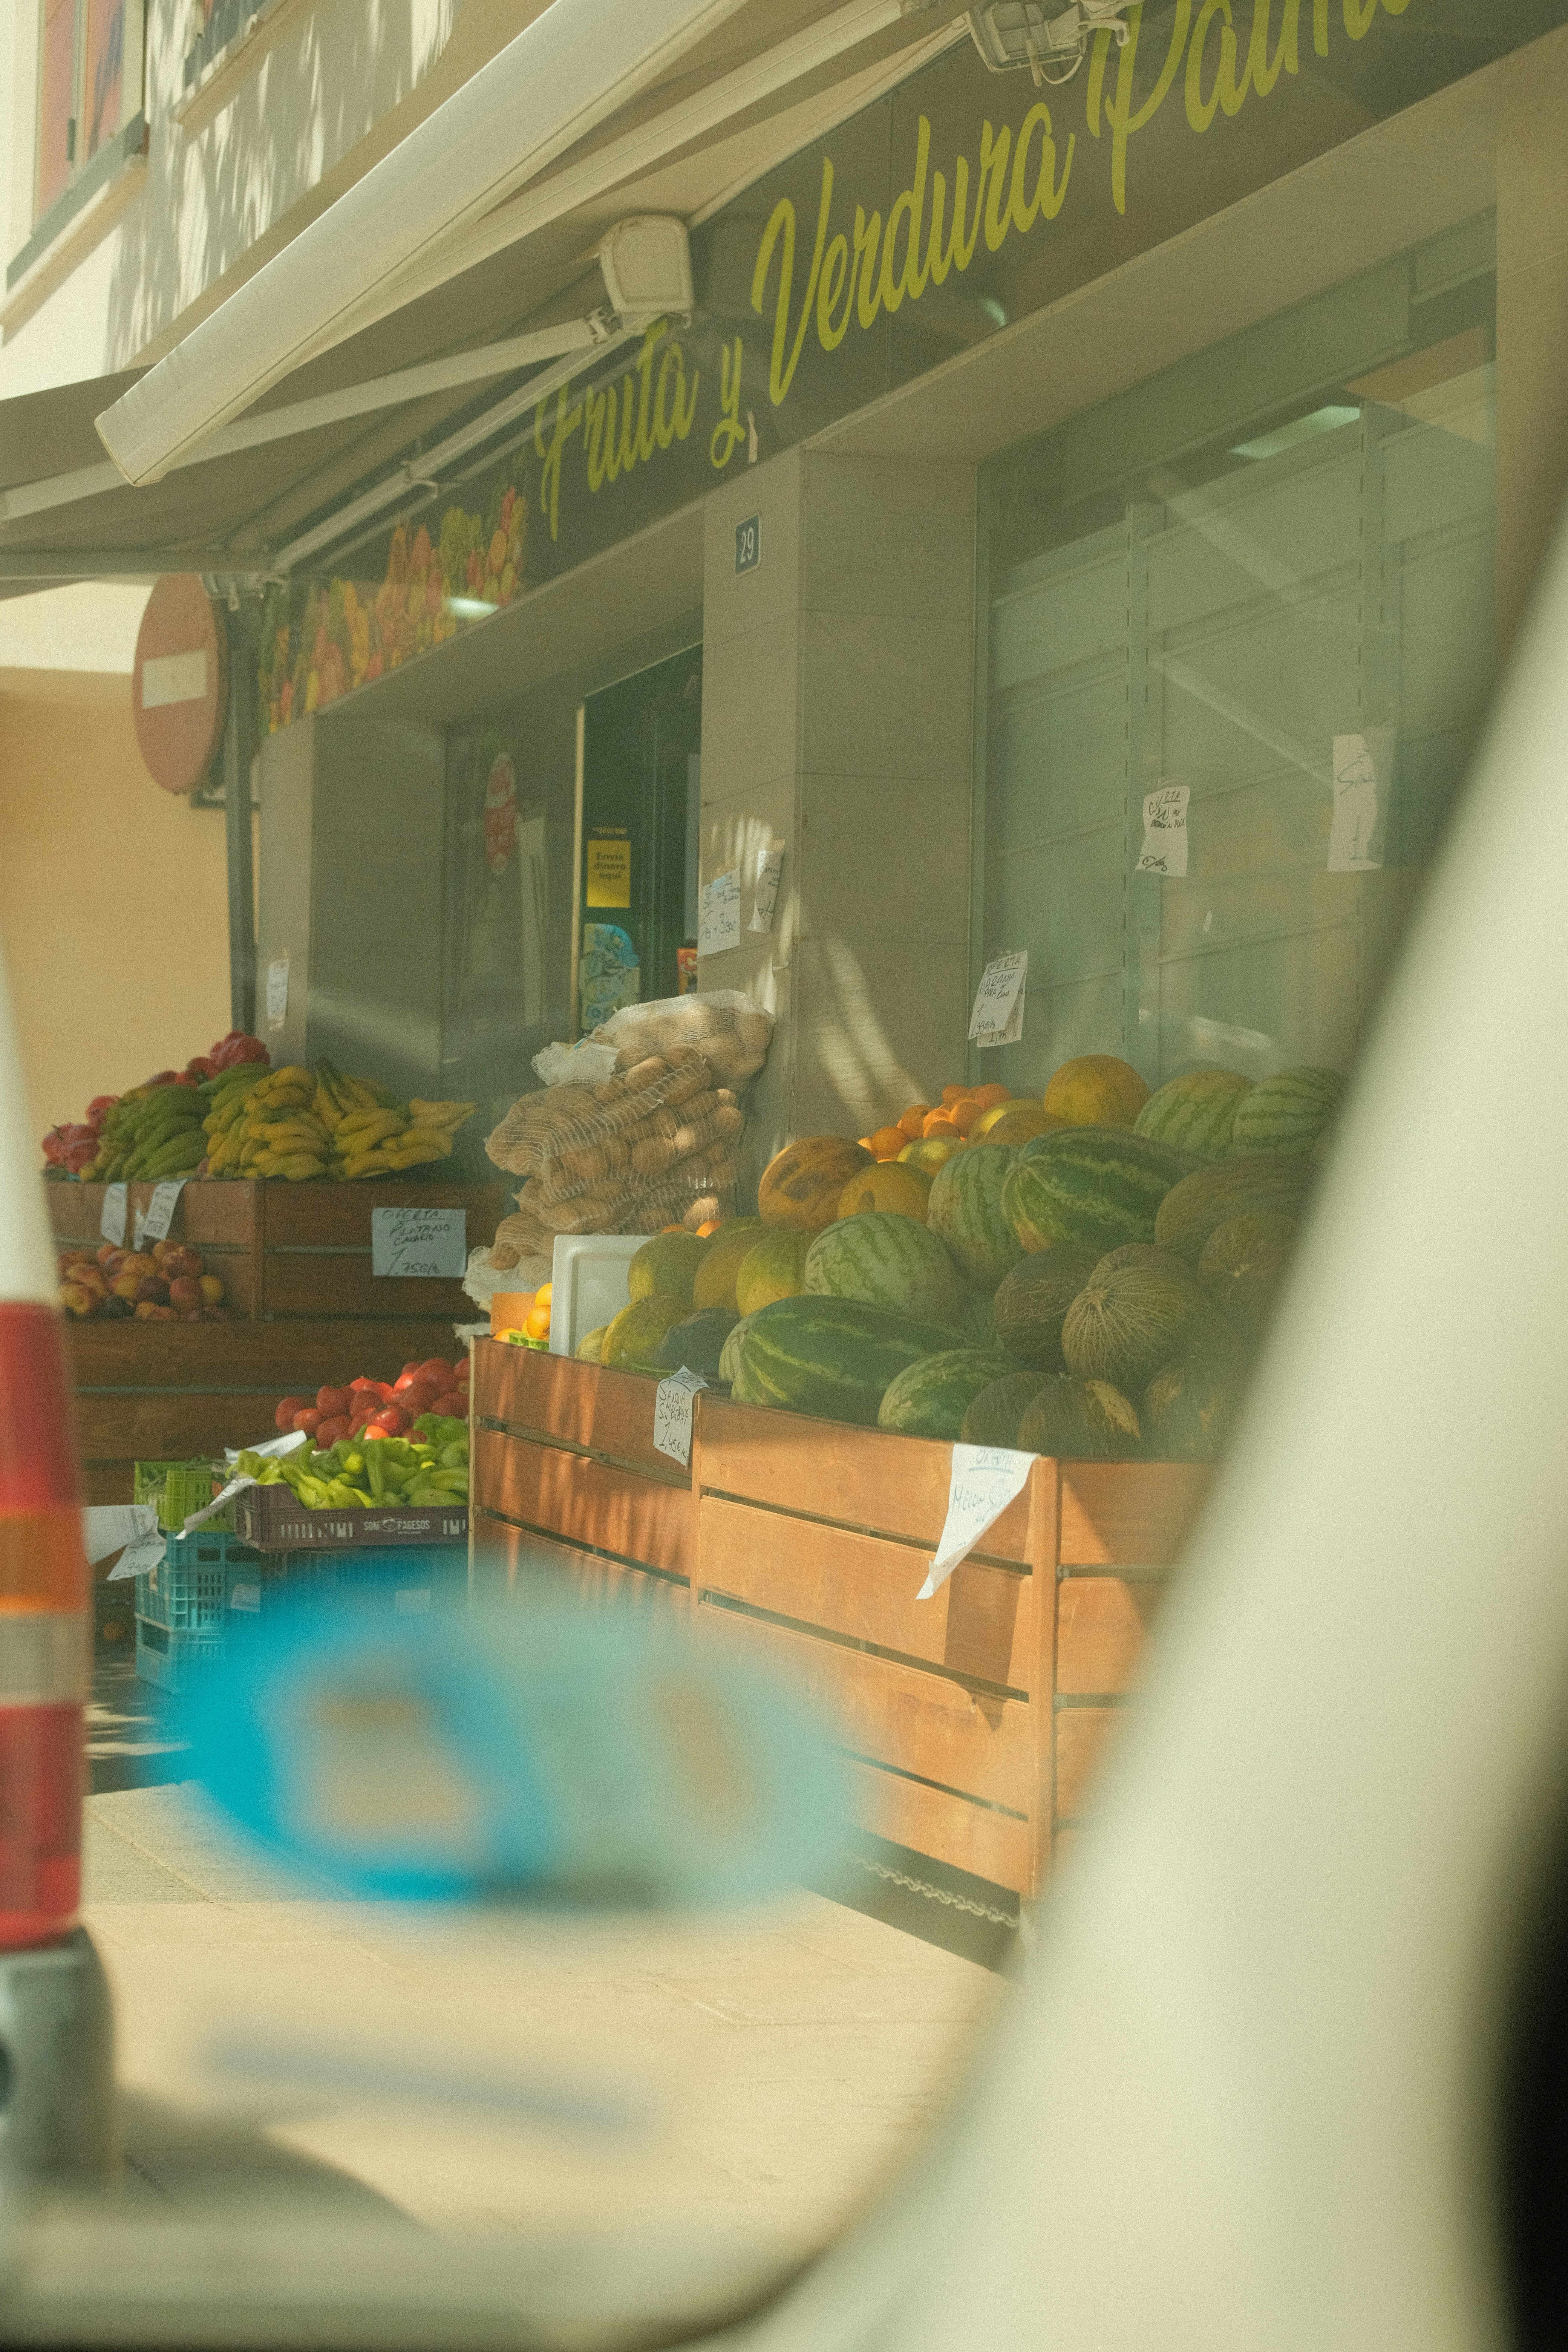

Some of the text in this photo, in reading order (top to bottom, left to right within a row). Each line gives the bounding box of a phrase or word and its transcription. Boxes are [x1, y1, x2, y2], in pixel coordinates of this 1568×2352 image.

[710, 337, 746, 469] y
[751, 103, 1076, 406] Verdura
[740, 527, 754, 563] 29
